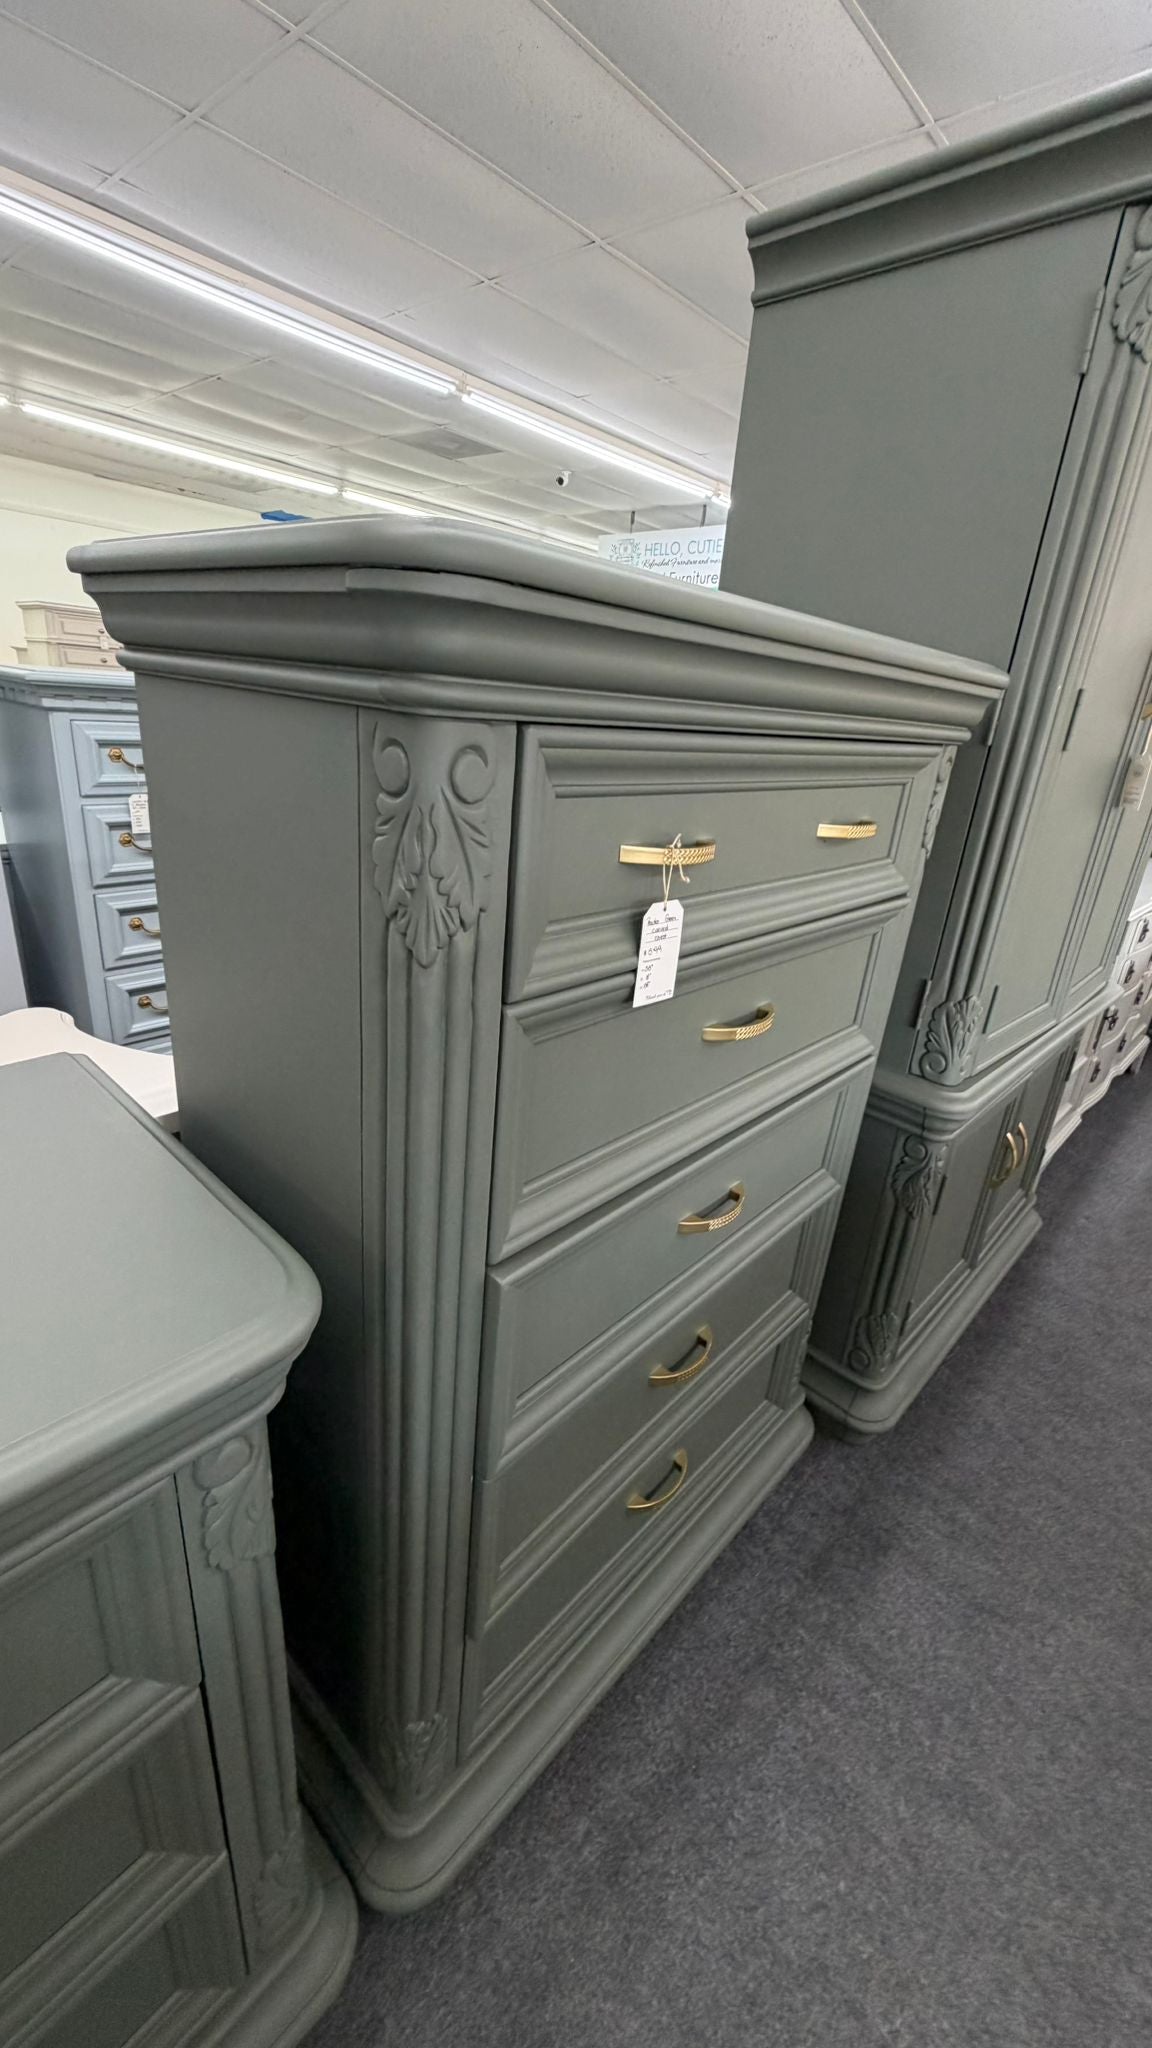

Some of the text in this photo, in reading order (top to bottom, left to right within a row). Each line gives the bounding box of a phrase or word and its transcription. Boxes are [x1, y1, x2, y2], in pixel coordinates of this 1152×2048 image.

[645, 538, 723, 558] HELLO, CUTIE
[698, 556, 710, 564] and
